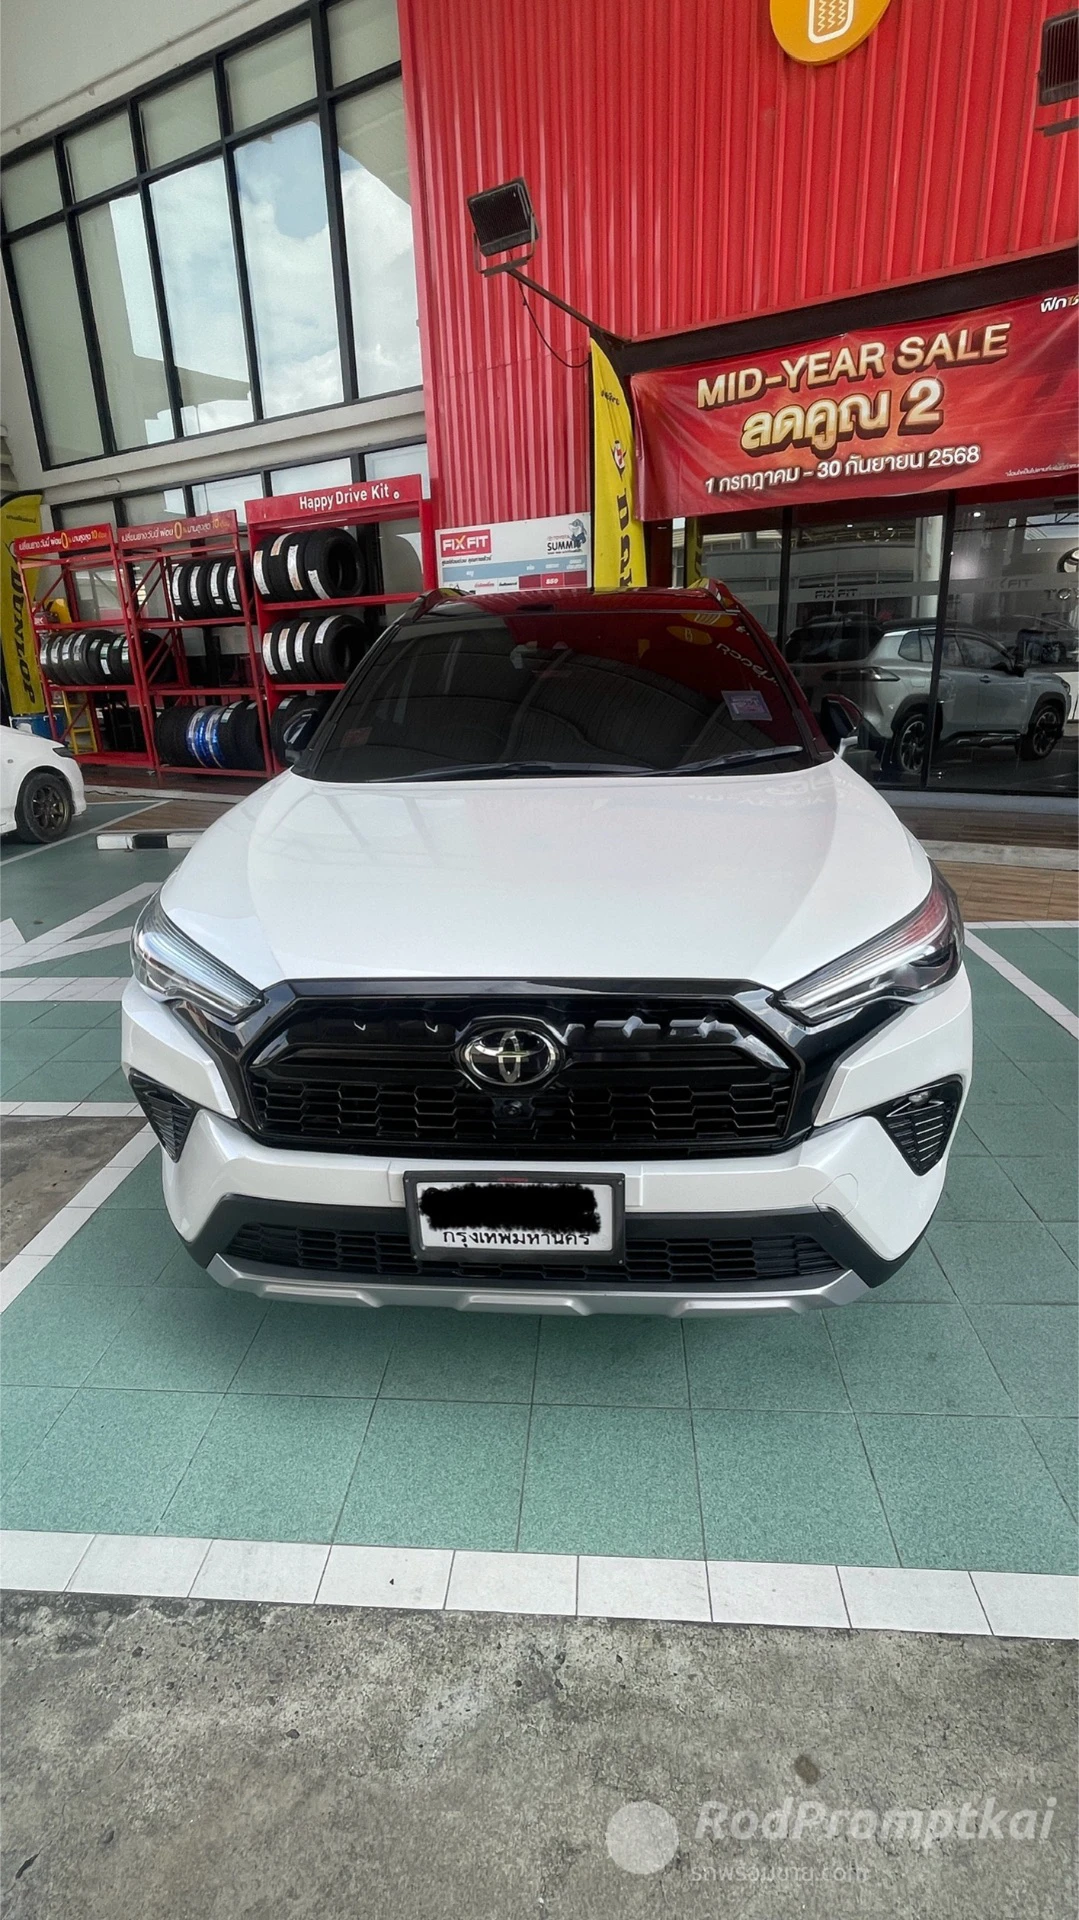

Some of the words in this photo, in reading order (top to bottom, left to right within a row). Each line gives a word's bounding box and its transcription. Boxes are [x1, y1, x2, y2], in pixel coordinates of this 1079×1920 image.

[697, 342, 886, 409] MID-YEAR
[895, 322, 1011, 371] SALE
[740, 390, 891, 453] ลดคูณ
[902, 377, 943, 430] 2
[299, 494, 334, 512] Happy
[335, 488, 367, 505] Drive
[371, 483, 390, 500] Kit
[705, 477, 714, 493] 1
[718, 467, 800, 490] กรกฎาคม
[817, 460, 841, 478] 30
[844, 454, 924, 476] กันยายน
[928, 446, 980, 467] 2568
[11, 566, 36, 704] DUNLOP
[442, 1230, 591, 1248] กรุงเทพมหานคร
